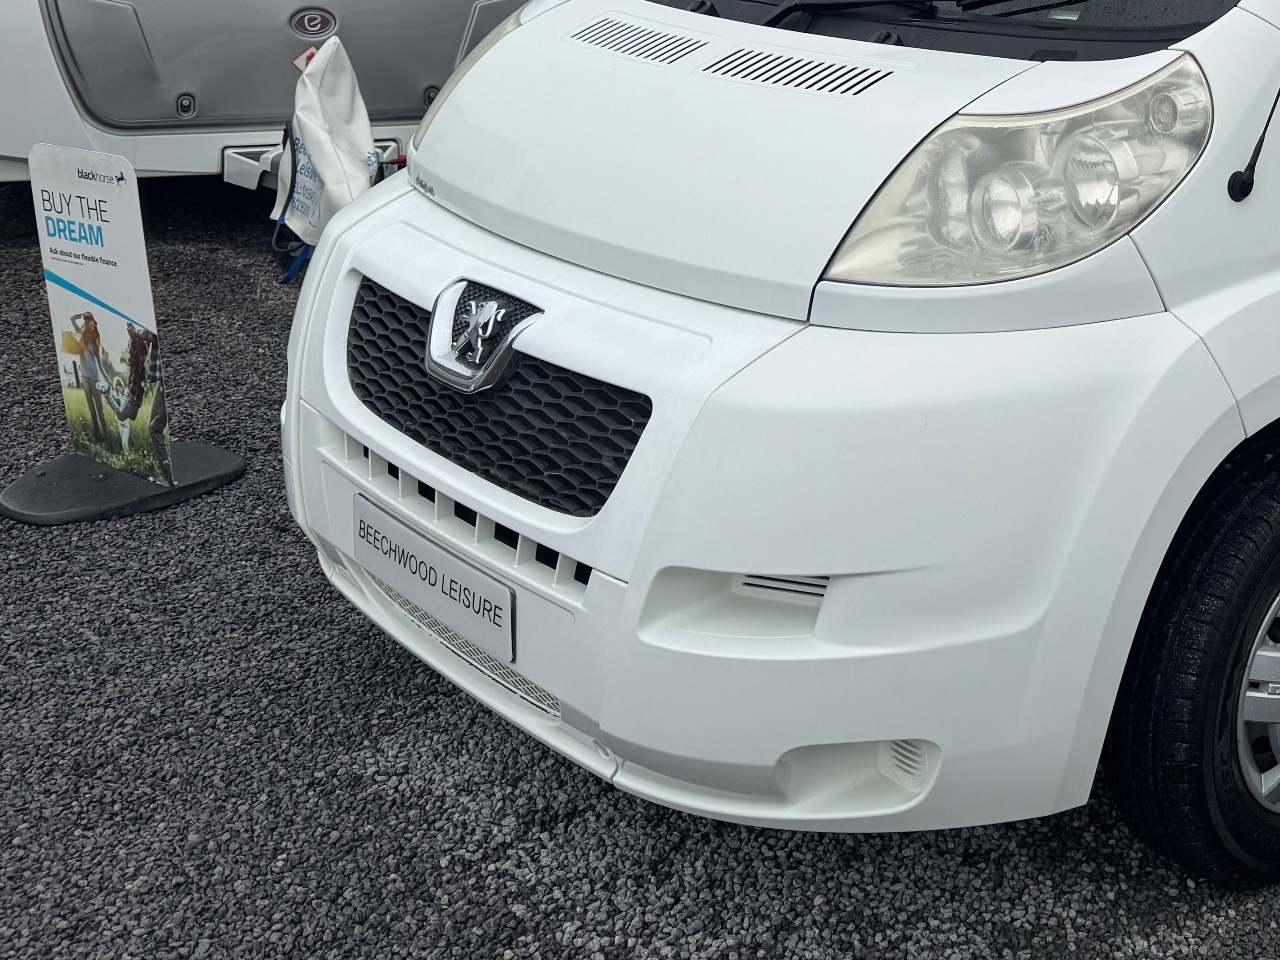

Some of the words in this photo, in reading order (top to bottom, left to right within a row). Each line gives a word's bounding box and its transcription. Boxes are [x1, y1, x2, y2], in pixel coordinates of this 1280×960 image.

[77, 167, 115, 185] blackhorse
[41, 189, 72, 216] BUY
[74, 195, 110, 223] THE
[45, 215, 105, 248] DREAM
[59, 249, 73, 259] about
[81, 253, 99, 264] flexible
[99, 256, 118, 267] finance
[358, 519, 438, 587] BEECHWOOD
[441, 573, 503, 628] LEISURE
